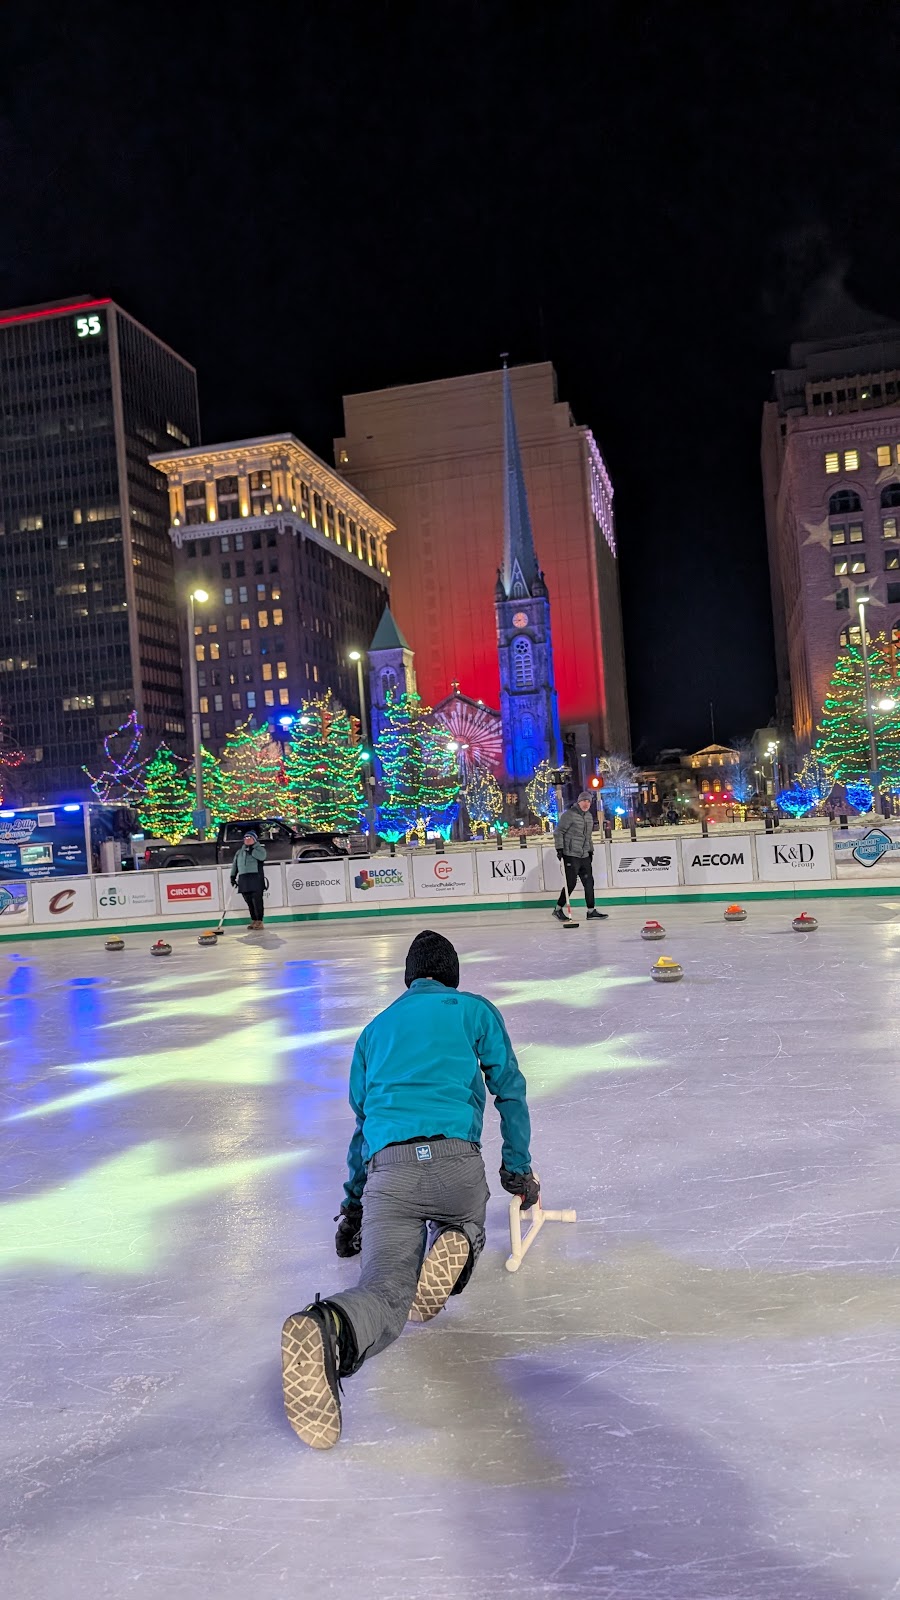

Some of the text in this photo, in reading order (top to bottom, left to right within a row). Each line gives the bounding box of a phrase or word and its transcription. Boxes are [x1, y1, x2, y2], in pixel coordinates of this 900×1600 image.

[76, 316, 101, 337] 55
[772, 843, 814, 864] K&D
[691, 852, 745, 867] AECOM
[791, 860, 815, 869] Group
[369, 869, 398, 878] BLOCK
[489, 859, 526, 878] K&D
[305, 879, 341, 887] BEDROCK
[375, 876, 404, 884] BLOCK
[170, 888, 196, 896] CIRCLE
[99, 895, 126, 907] CSU
